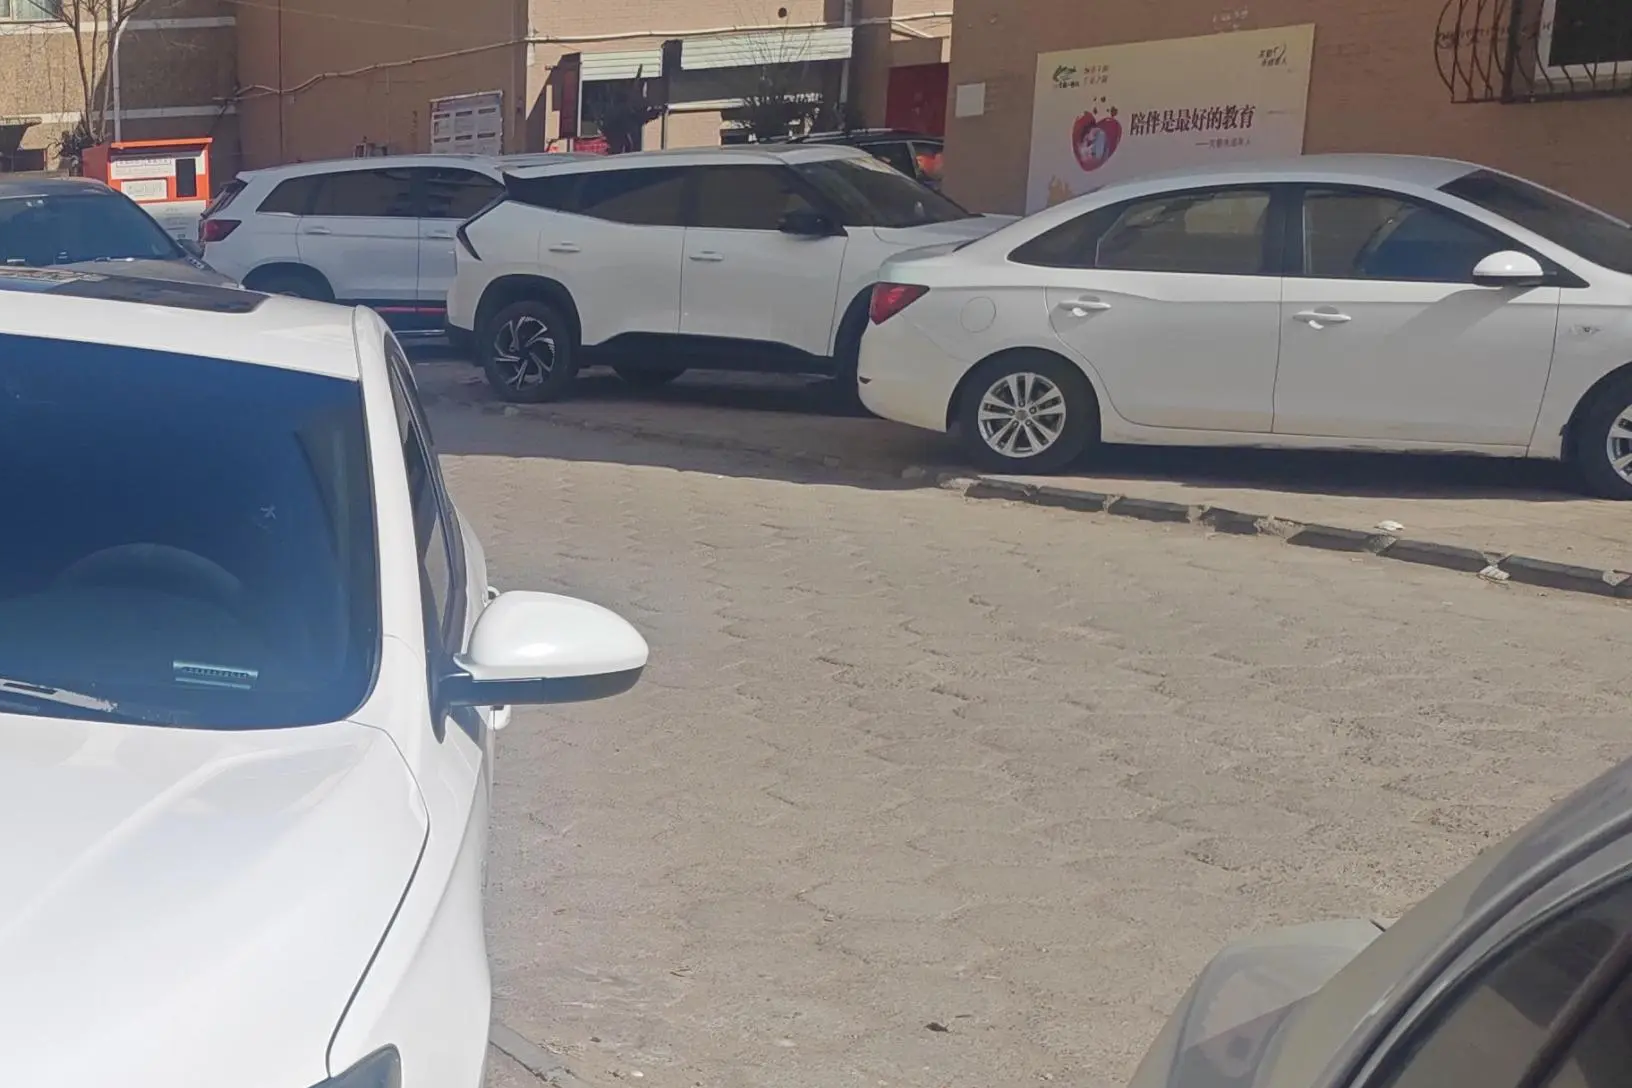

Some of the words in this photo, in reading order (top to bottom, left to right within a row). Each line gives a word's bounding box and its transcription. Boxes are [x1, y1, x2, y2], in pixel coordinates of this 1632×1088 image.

[1129, 104, 1256, 136] 陪伴是最好的教育
